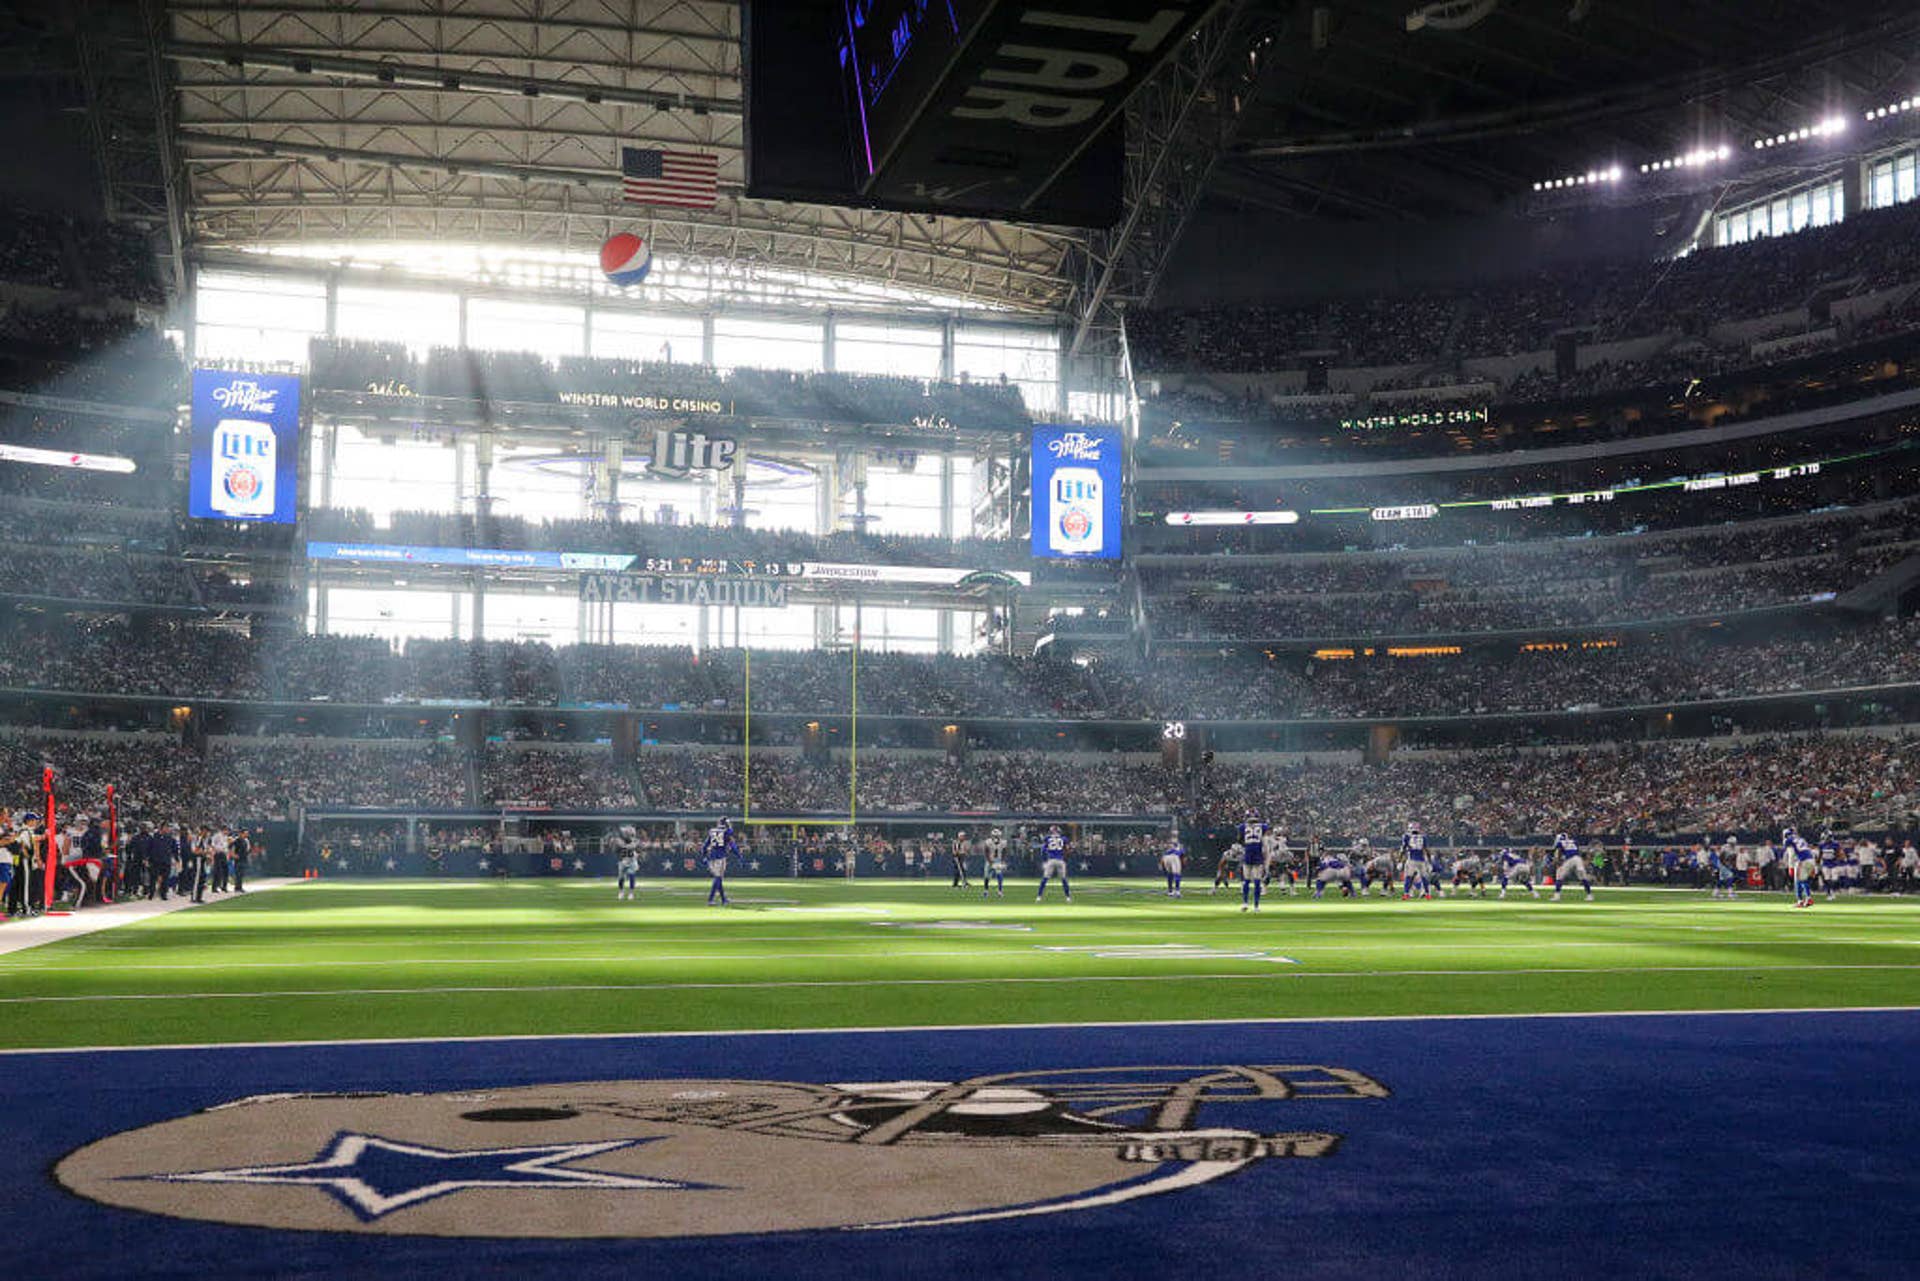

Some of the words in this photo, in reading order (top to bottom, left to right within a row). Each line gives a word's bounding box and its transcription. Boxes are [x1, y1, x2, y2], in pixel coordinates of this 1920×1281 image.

[558, 391, 618, 406] WINSTAR
[621, 396, 669, 410] WORLD
[672, 398, 721, 413] CASINO
[1339, 415, 1396, 430] WINSTAR
[1398, 411, 1444, 426] WORLD
[222, 431, 269, 460] Lite
[645, 428, 738, 478] Lite
[1057, 479, 1097, 504] Lite
[1375, 507, 1402, 519] TEAM
[646, 558, 672, 571] 5:21
[765, 563, 779, 575] 13
[584, 575, 653, 603] AT&T
[660, 578, 787, 608] STADIUM
[1163, 722, 1184, 738] 20
[710, 831, 724, 846] 24
[1244, 826, 1262, 843] 29
[1048, 838, 1064, 850] 20
